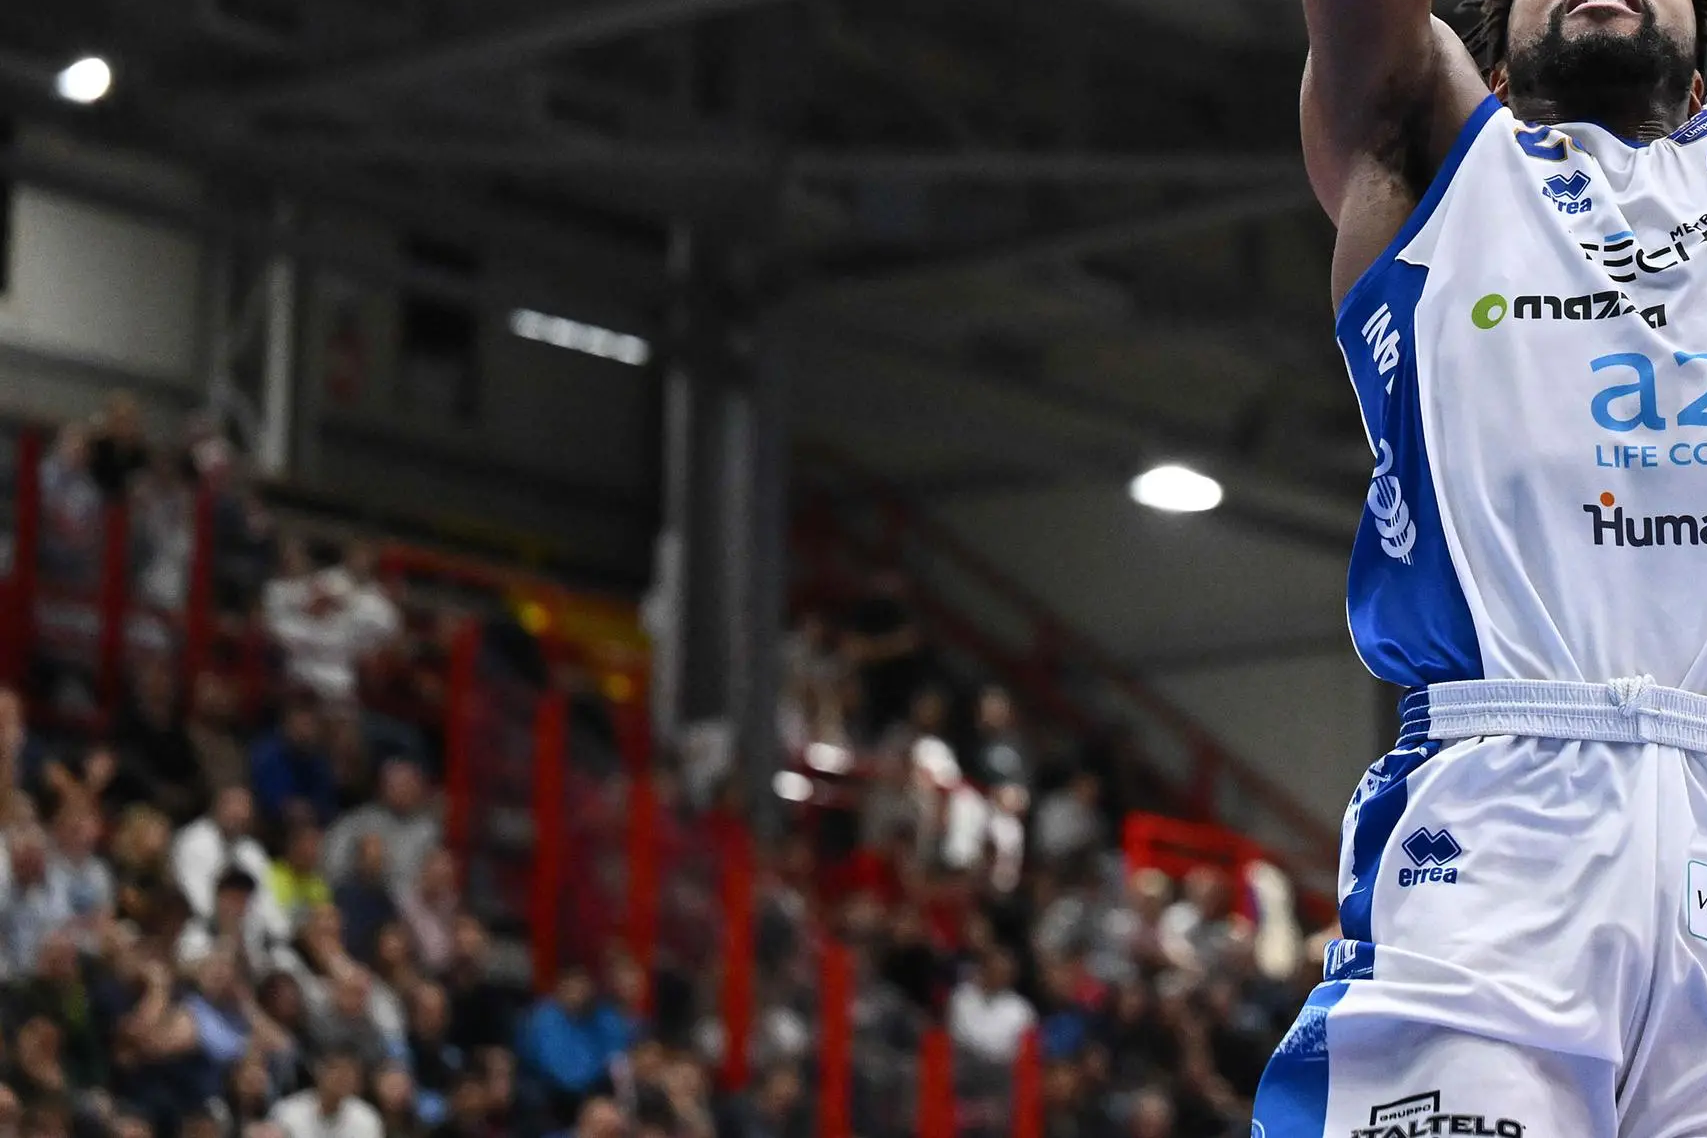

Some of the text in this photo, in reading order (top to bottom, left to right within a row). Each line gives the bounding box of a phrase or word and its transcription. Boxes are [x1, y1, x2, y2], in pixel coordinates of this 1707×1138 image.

[1596, 444, 1658, 469] LIFE
[1399, 867, 1458, 888] errea
[1379, 1104, 1432, 1122] GRUPPO
